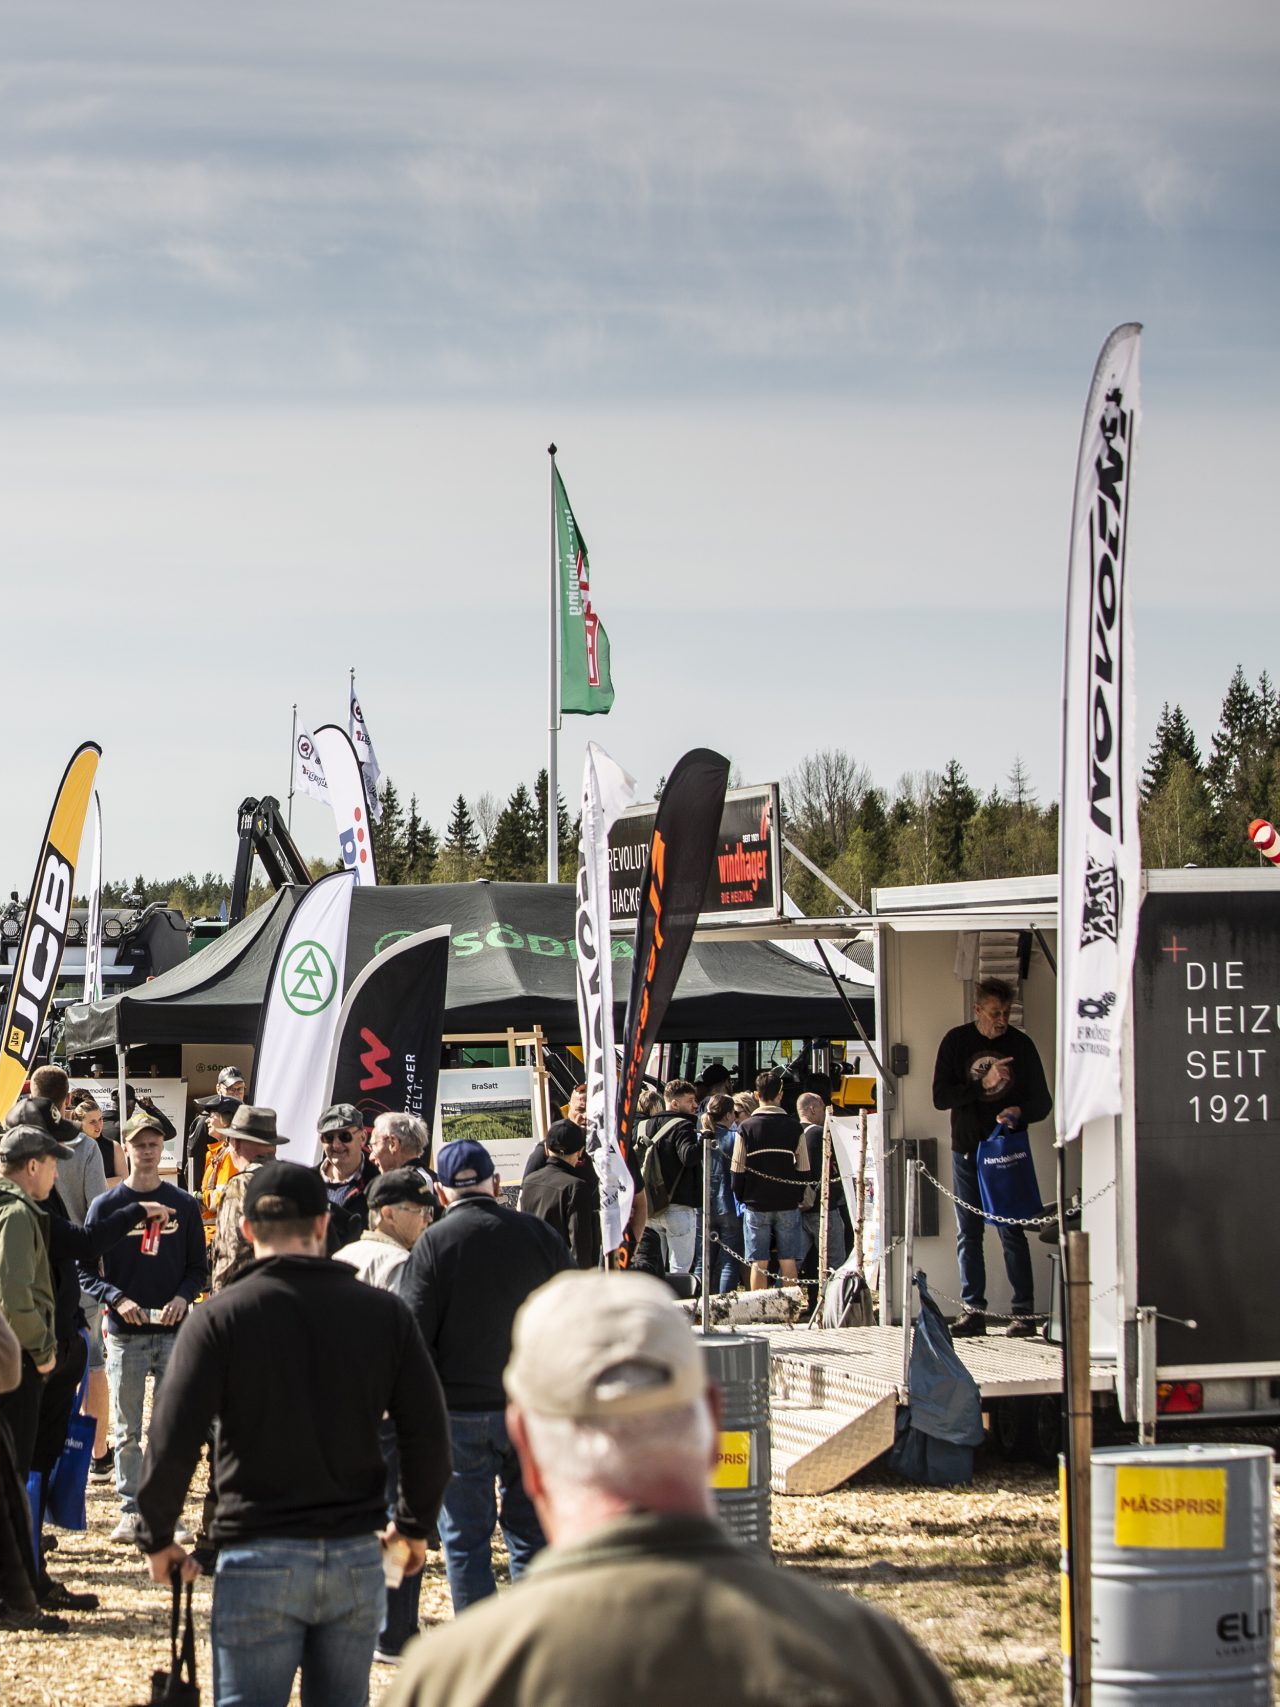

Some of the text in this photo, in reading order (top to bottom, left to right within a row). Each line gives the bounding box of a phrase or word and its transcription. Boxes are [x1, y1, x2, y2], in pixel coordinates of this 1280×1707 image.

[717, 842, 767, 892] windhager
[611, 886, 642, 913] HACKG
[15, 854, 70, 1061] JCB
[1186, 961, 1245, 990] DIE
[1187, 1004, 1280, 1034] HEIZ
[1186, 1049, 1266, 1079] SEIT
[471, 1082, 499, 1090] BraSatt
[1189, 1093, 1268, 1123] 1921
[715, 1453, 748, 1465] PRIS!
[1120, 1493, 1223, 1516] MÄSSPRIS!
